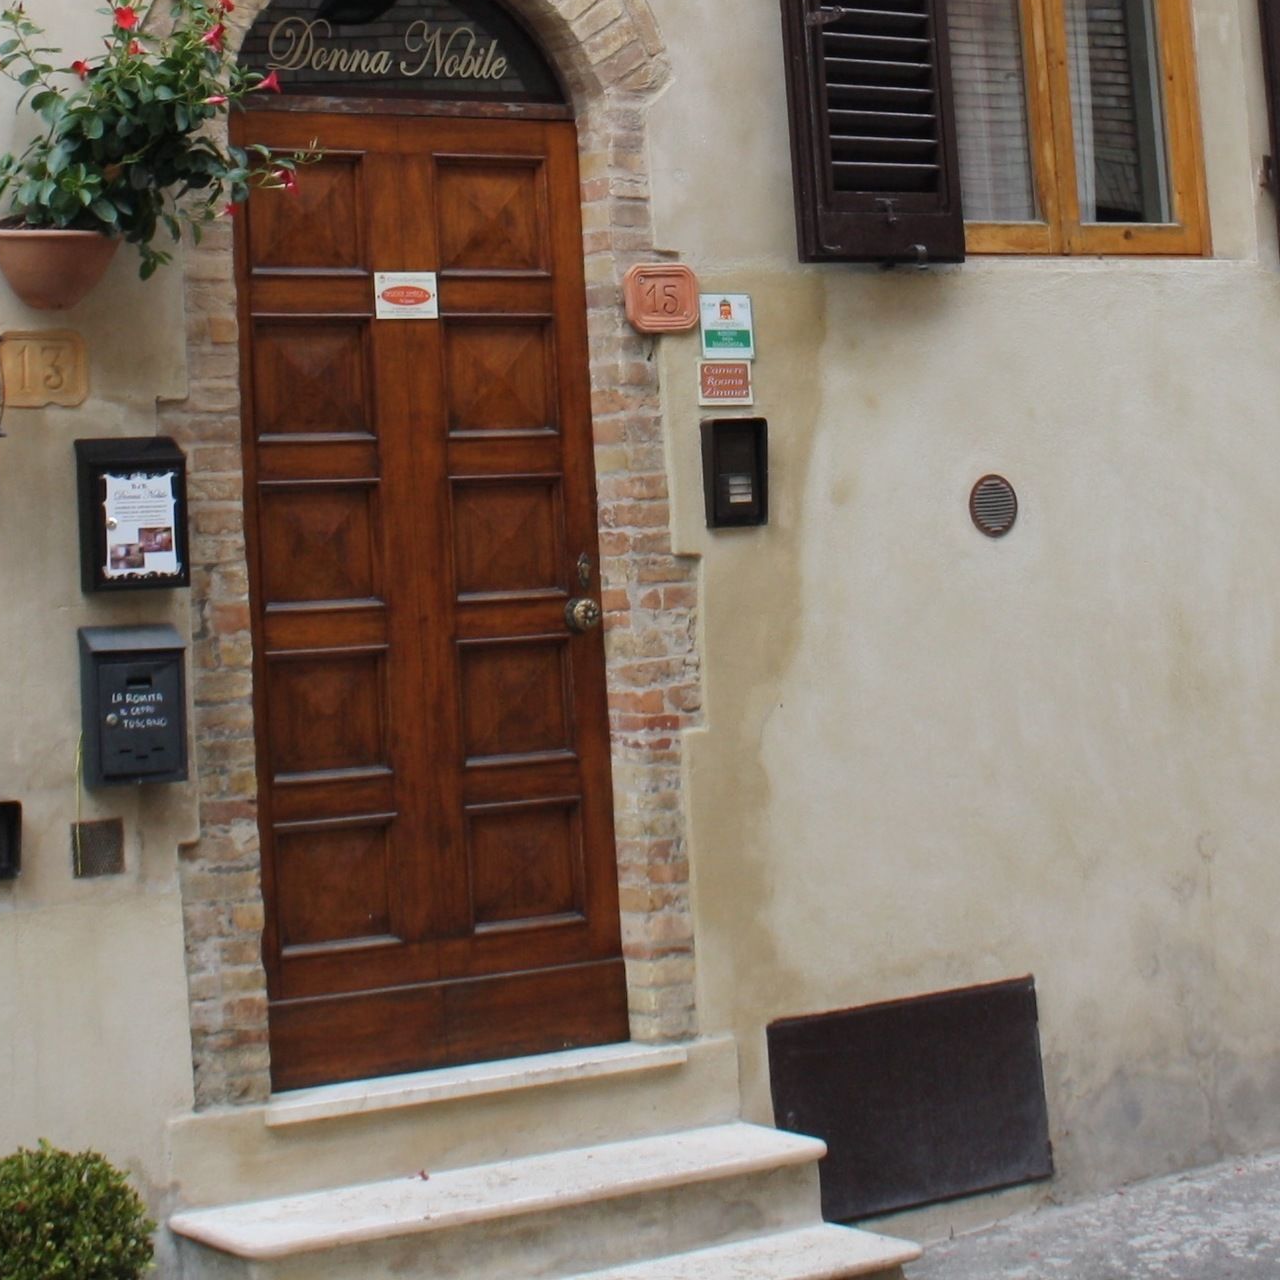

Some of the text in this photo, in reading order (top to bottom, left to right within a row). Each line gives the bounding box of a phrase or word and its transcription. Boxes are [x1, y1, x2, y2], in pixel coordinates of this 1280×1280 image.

[266, 16, 508, 81] Donna Nobile
[645, 283, 680, 315] 15
[16, 344, 67, 392] 13
[703, 365, 745, 376] Camere
[706, 376, 744, 386] Rooms
[703, 387, 749, 398] Zimmer
[111, 692, 123, 704] LA
